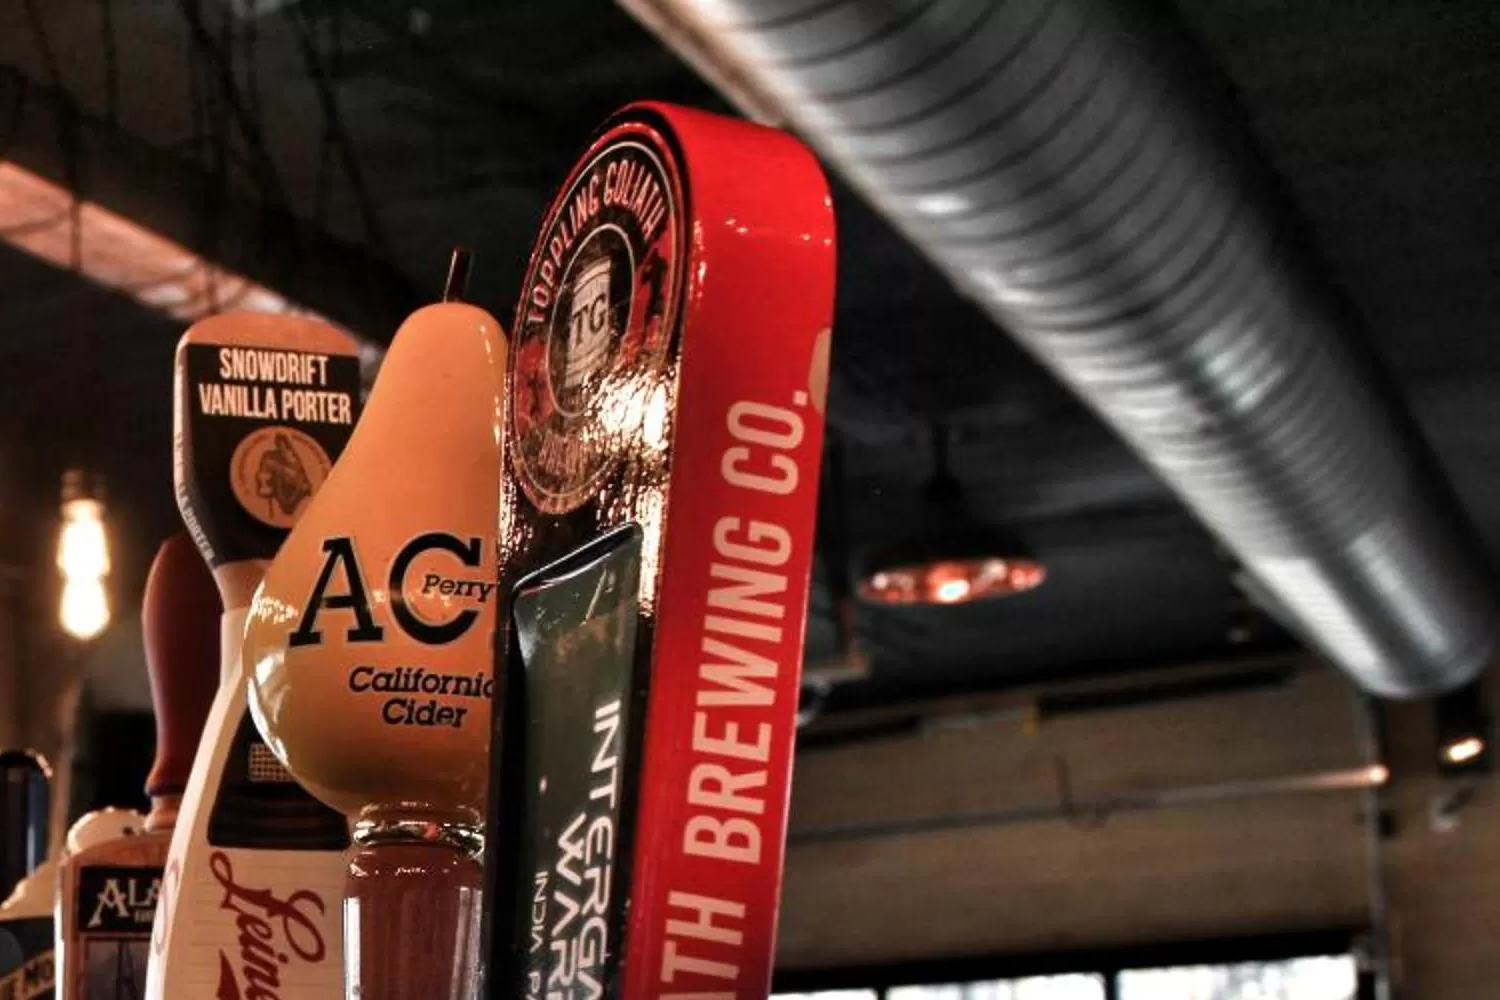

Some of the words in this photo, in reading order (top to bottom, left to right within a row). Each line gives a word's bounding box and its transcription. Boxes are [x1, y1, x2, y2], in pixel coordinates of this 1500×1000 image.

[527, 173, 599, 324] TOPPLING
[603, 158, 666, 242] GOLIATH
[572, 292, 607, 347] TG
[219, 347, 329, 387] SNOWDRIFT
[198, 383, 279, 420] VANILLA
[281, 387, 352, 425] PORTER
[719, 390, 808, 496] CO.
[421, 573, 495, 603] Perry
[381, 698, 469, 728] Cider
[682, 515, 795, 866] BREWING
